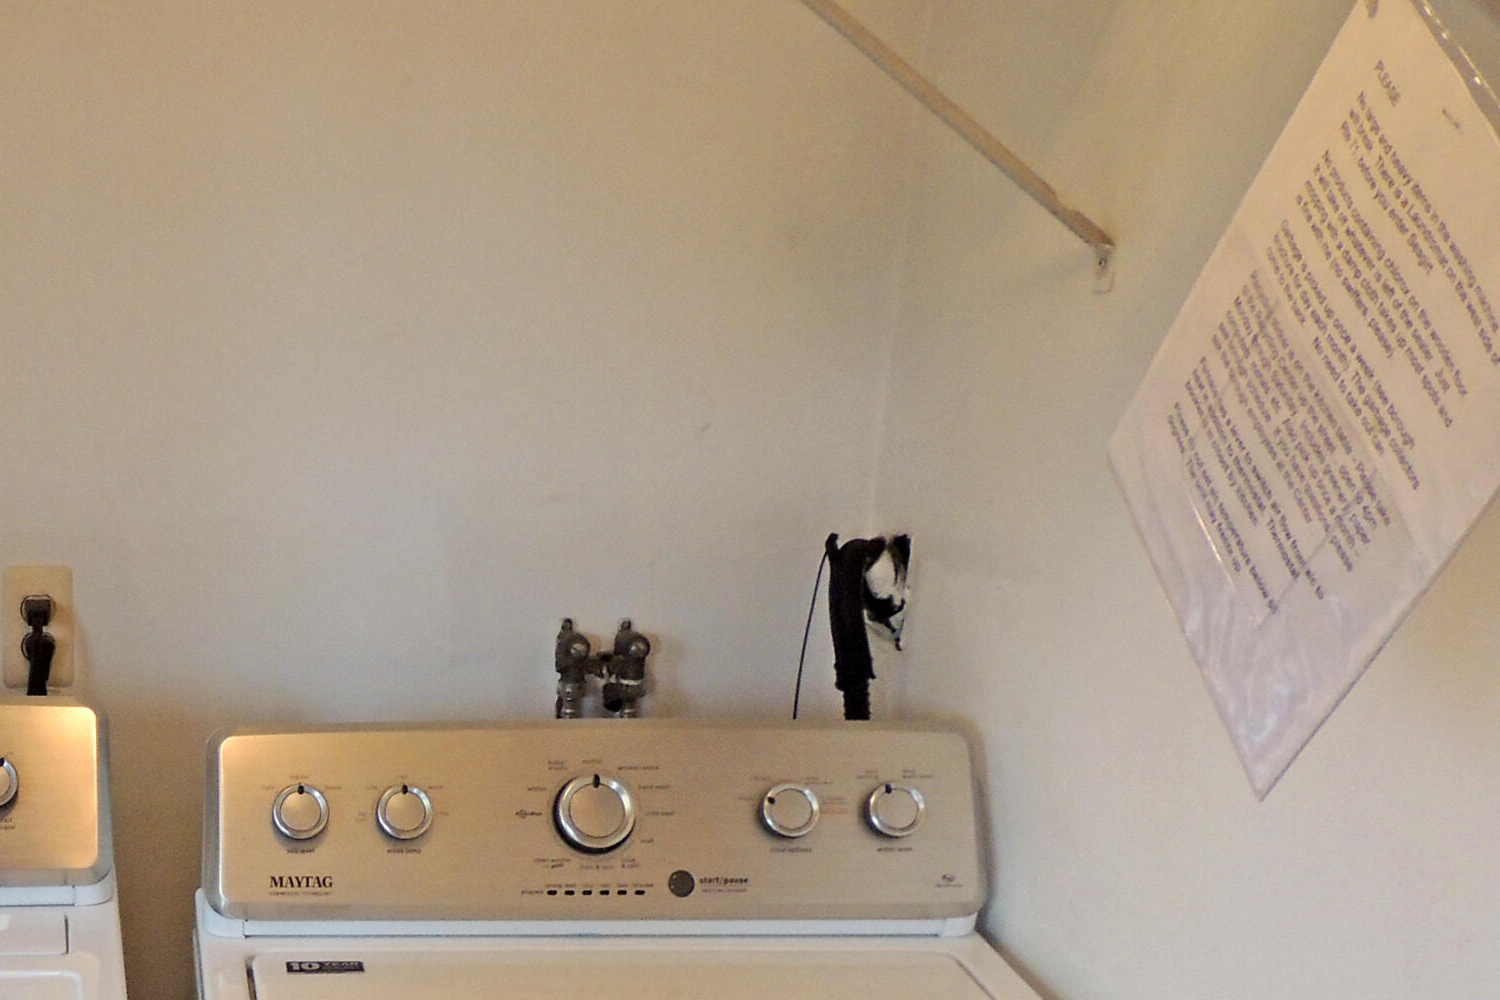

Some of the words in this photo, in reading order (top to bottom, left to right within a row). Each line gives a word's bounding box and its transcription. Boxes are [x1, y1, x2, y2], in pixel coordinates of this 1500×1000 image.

[1373, 188, 1390, 211] you
[1351, 208, 1385, 261] containing
[1342, 249, 1362, 279] damp
[269, 875, 333, 888] MAYTAG
[699, 876, 749, 887] start/pause
[288, 962, 321, 971] 10
